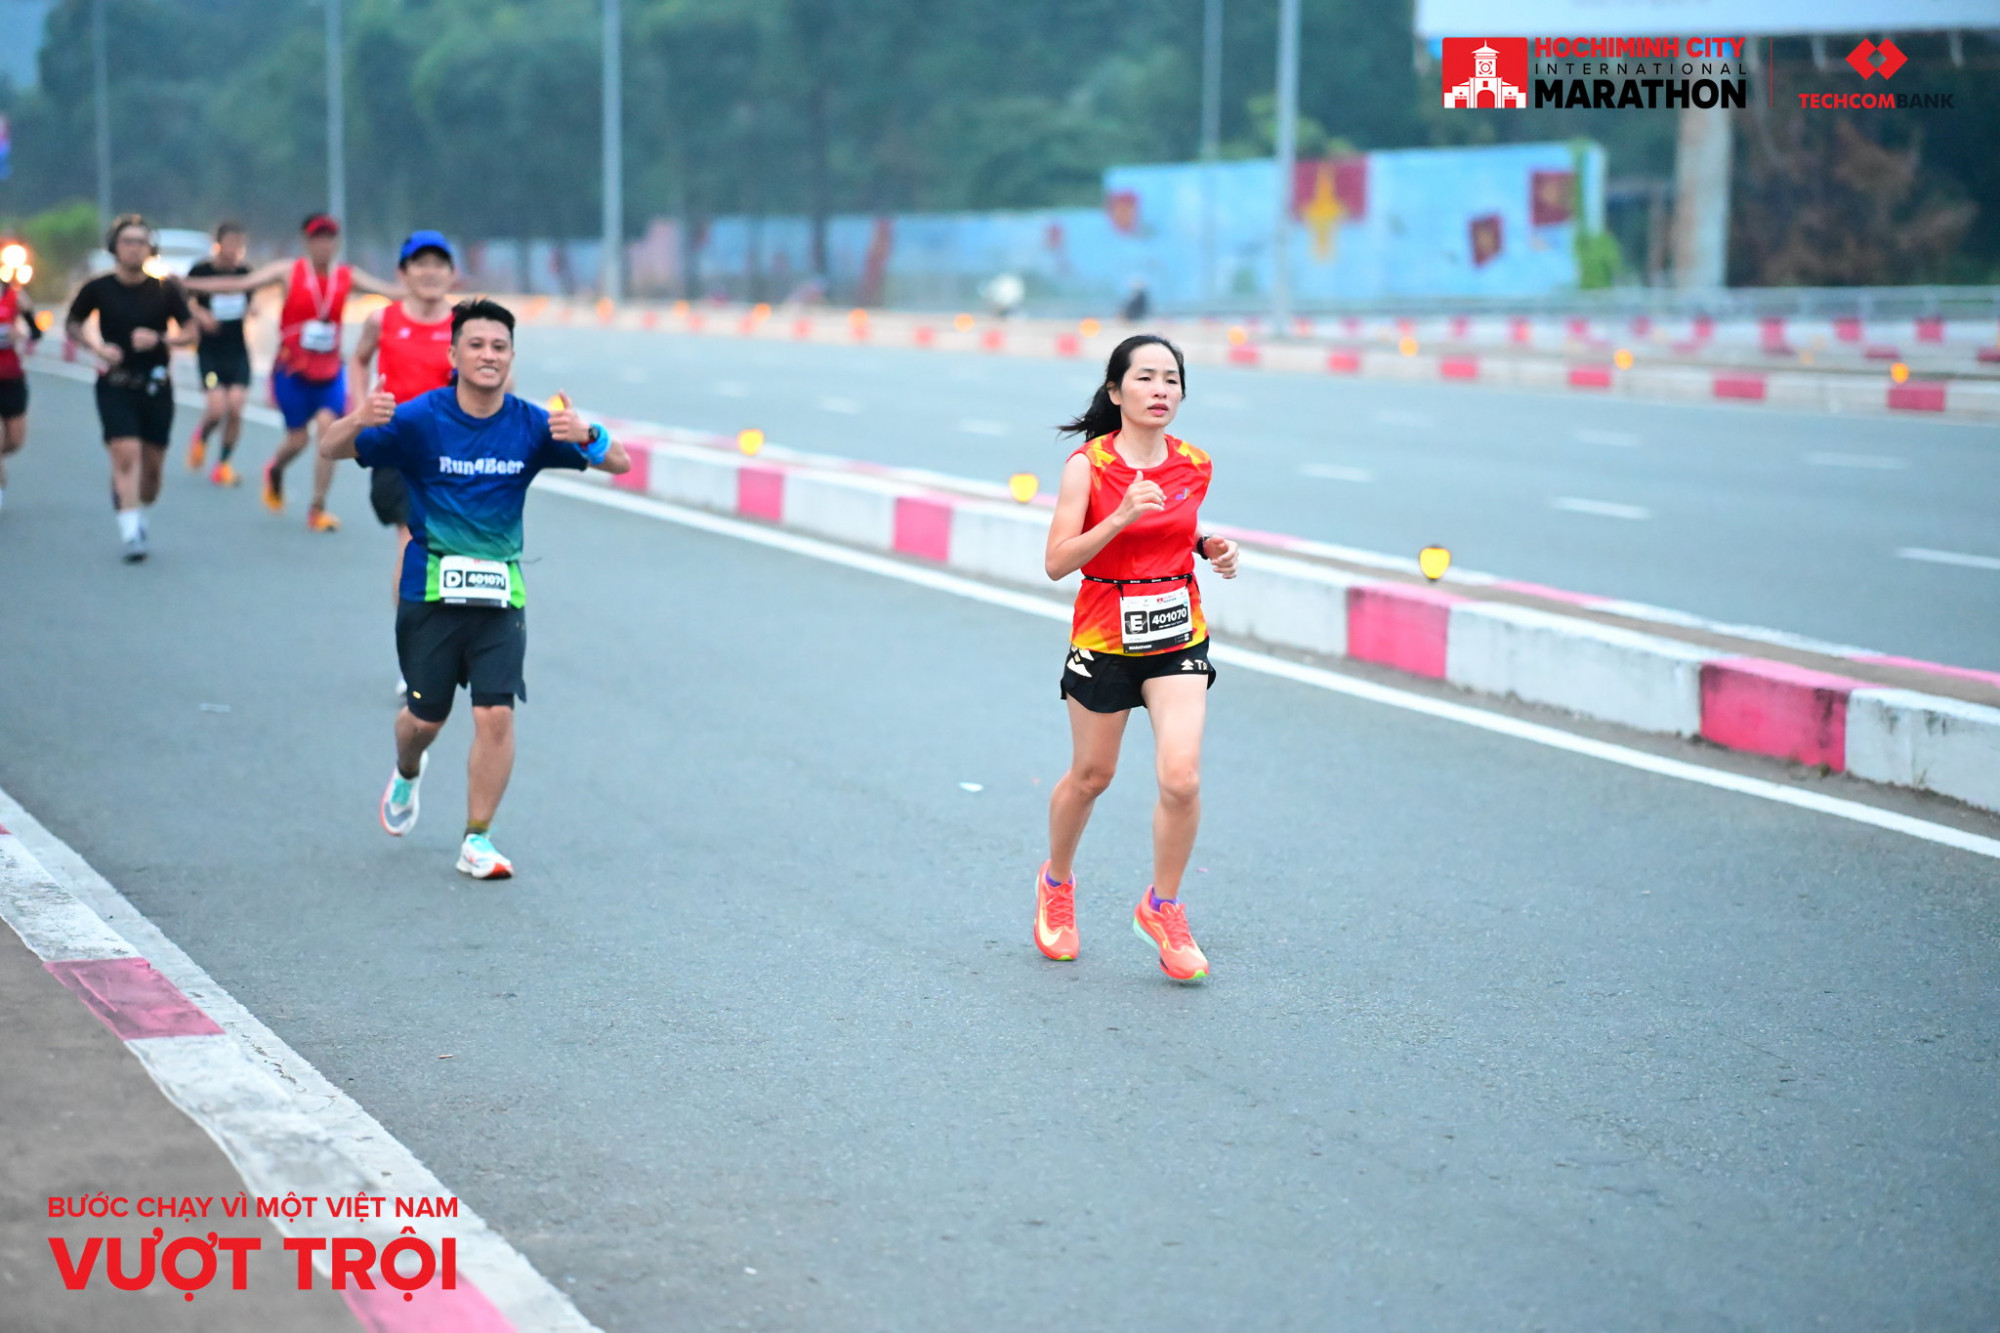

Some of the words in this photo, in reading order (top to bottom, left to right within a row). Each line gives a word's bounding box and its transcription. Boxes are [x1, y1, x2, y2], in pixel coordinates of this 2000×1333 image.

[439, 456, 525, 475] Run4Beer
[446, 571, 462, 588] D
[468, 573, 505, 587] 401071
[1130, 614, 1143, 631] E
[1152, 608, 1187, 625] 401070
